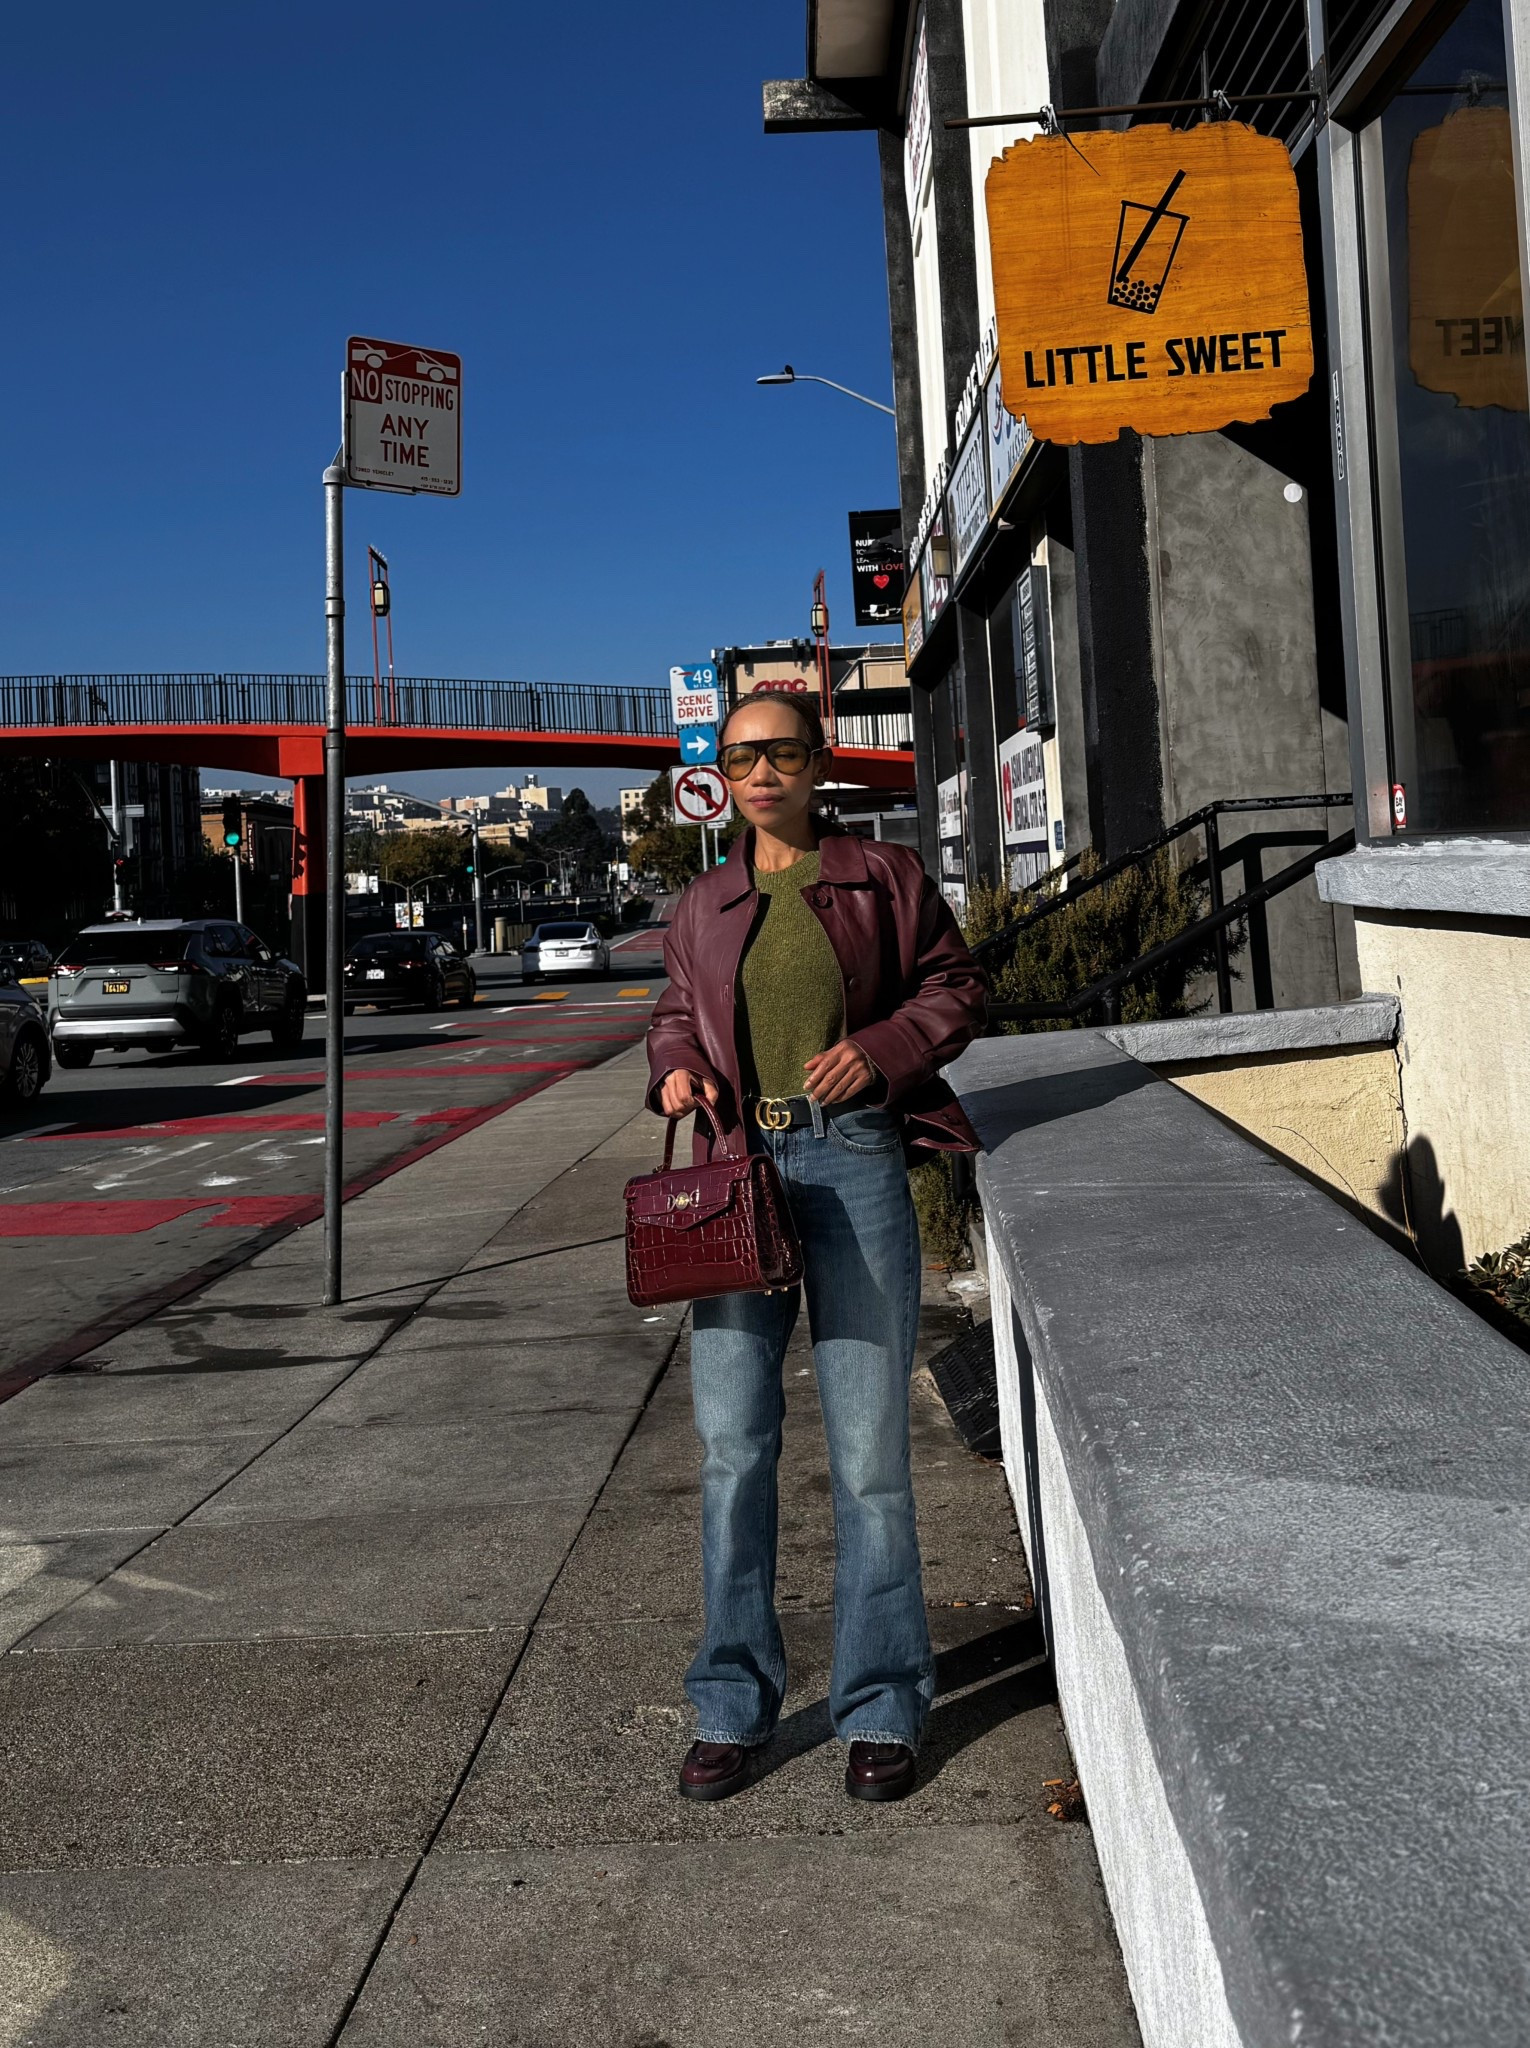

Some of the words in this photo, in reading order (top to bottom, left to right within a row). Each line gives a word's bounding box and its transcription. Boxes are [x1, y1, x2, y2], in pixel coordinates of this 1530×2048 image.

[1024, 341, 1148, 388] LITTLE
[1165, 330, 1287, 377] SWEET
[351, 367, 379, 400] NO
[385, 379, 454, 411] STOPPING
[380, 413, 430, 440] ANY
[380, 440, 430, 468] TIME
[856, 564, 879, 573] WITH
[881, 563, 904, 571] LOVE
[692, 669, 713, 684] 49
[677, 694, 712, 706] SCENIC
[678, 706, 713, 719] DRIVE
